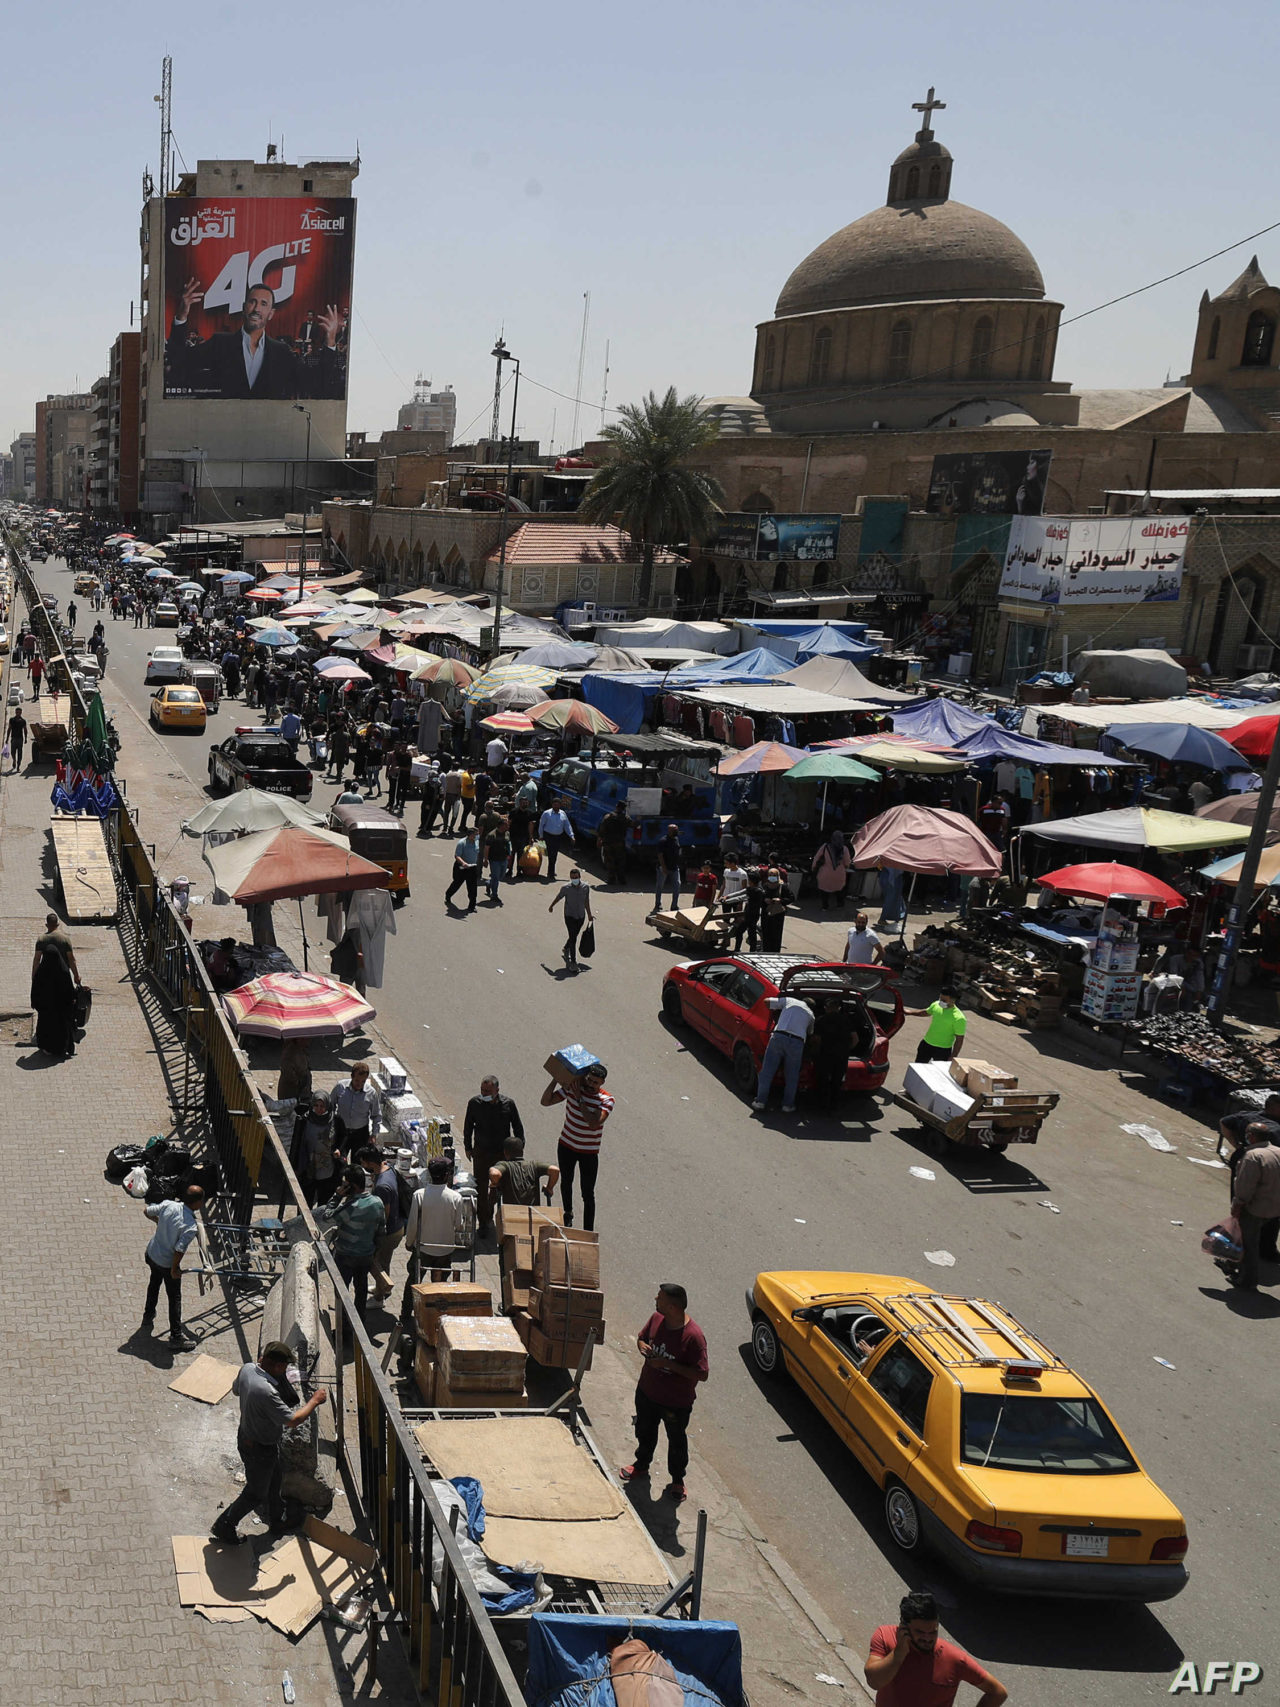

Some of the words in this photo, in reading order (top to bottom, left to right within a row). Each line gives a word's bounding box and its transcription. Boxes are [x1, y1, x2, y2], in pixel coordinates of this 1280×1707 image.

[170, 216, 236, 246] العراق
[300, 212, 345, 231] Asiacell
[284, 237, 312, 258] LTE
[1069, 548, 1135, 579] السوداني
[1140, 550, 1182, 569] حيدر
